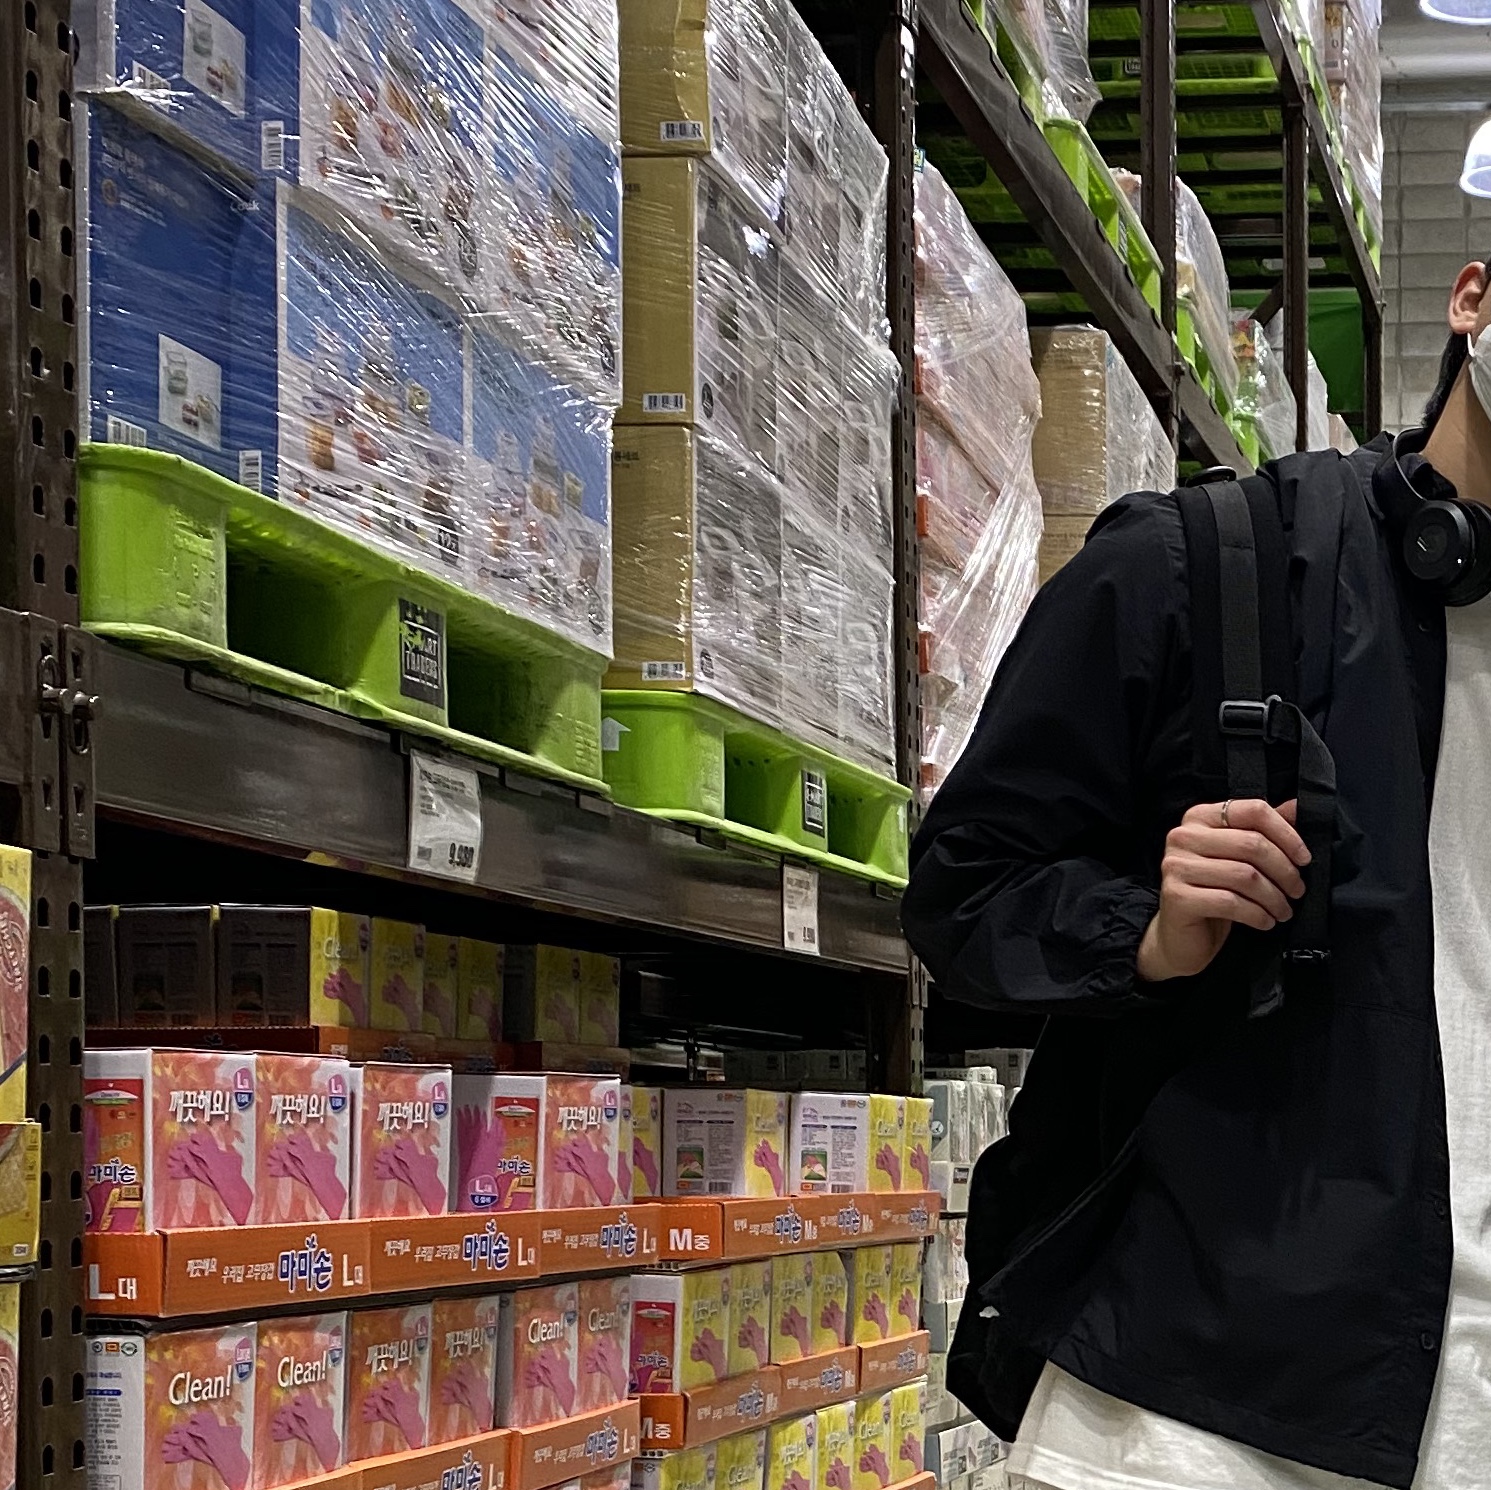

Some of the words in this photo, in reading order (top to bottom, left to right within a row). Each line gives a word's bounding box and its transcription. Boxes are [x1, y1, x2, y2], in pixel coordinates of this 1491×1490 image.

[169, 1090, 229, 1123] 깨끗해요!
[270, 1094, 325, 1124] 깨끗해요!
[377, 1101, 429, 1130] 깨끗해요!
[557, 1106, 601, 1130] 깨끗해요!
[462, 1232, 510, 1271] 마미손
[599, 1223, 637, 1258] 마미손
[669, 1228, 710, 1251] M중
[89, 1264, 137, 1300] L대
[278, 1249, 333, 1292] 마미손
[528, 1312, 563, 1344] Clean!
[169, 1366, 232, 1405] Clean!
[277, 1351, 326, 1387] Clean!
